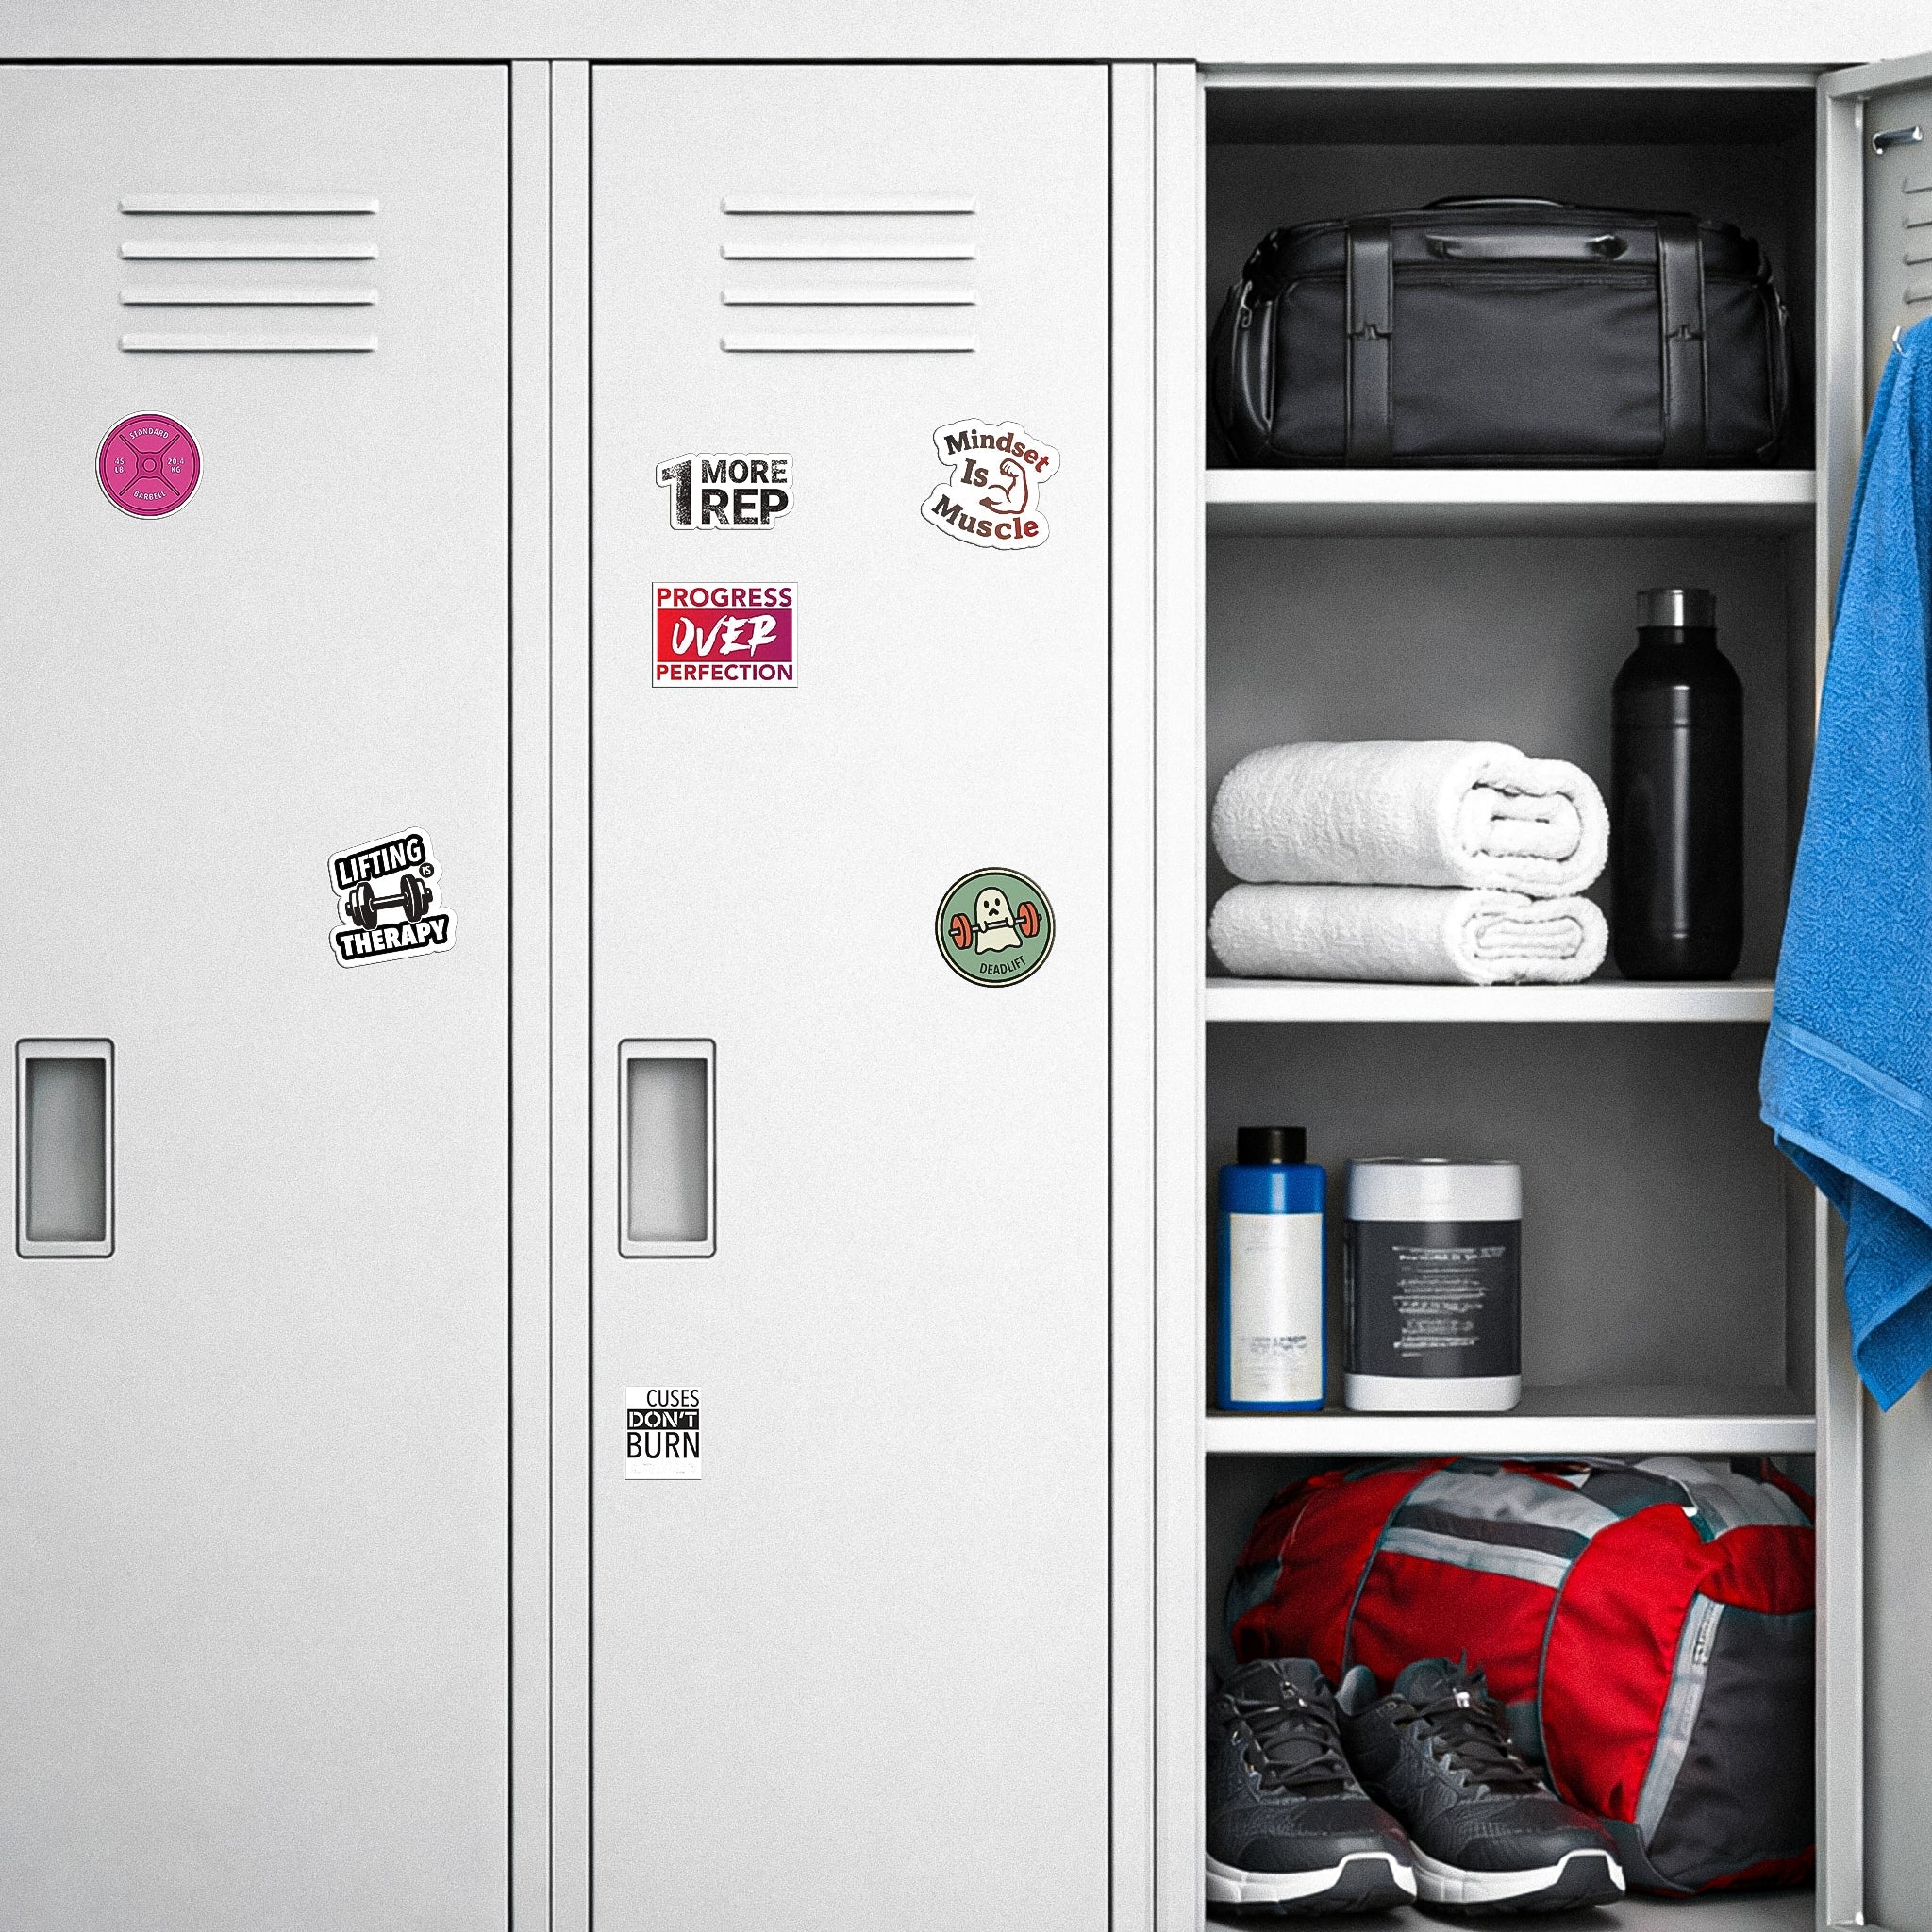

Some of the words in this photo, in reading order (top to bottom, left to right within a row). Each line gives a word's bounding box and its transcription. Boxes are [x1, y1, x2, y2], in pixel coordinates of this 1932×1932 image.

[129, 427, 169, 440] STANDARD
[943, 428, 1049, 473] Mindset
[960, 458, 989, 487] Is
[133, 490, 167, 501] BARBELL
[661, 459, 692, 525] 1
[701, 459, 788, 484] MORE
[701, 488, 789, 525] REP
[931, 493, 1039, 540] Muscle
[657, 587, 792, 607] PROGRESS
[672, 614, 777, 657] OVER
[656, 664, 793, 680] PERFECTION
[339, 838, 423, 886] LIFTING
[421, 865, 432, 876] IS
[340, 918, 446, 957] THERAPY
[979, 955, 1026, 975] DEADLIFT
[647, 1389, 700, 1407] CUSES
[628, 1410, 698, 1428] DON'T
[627, 1431, 700, 1458] BURN
